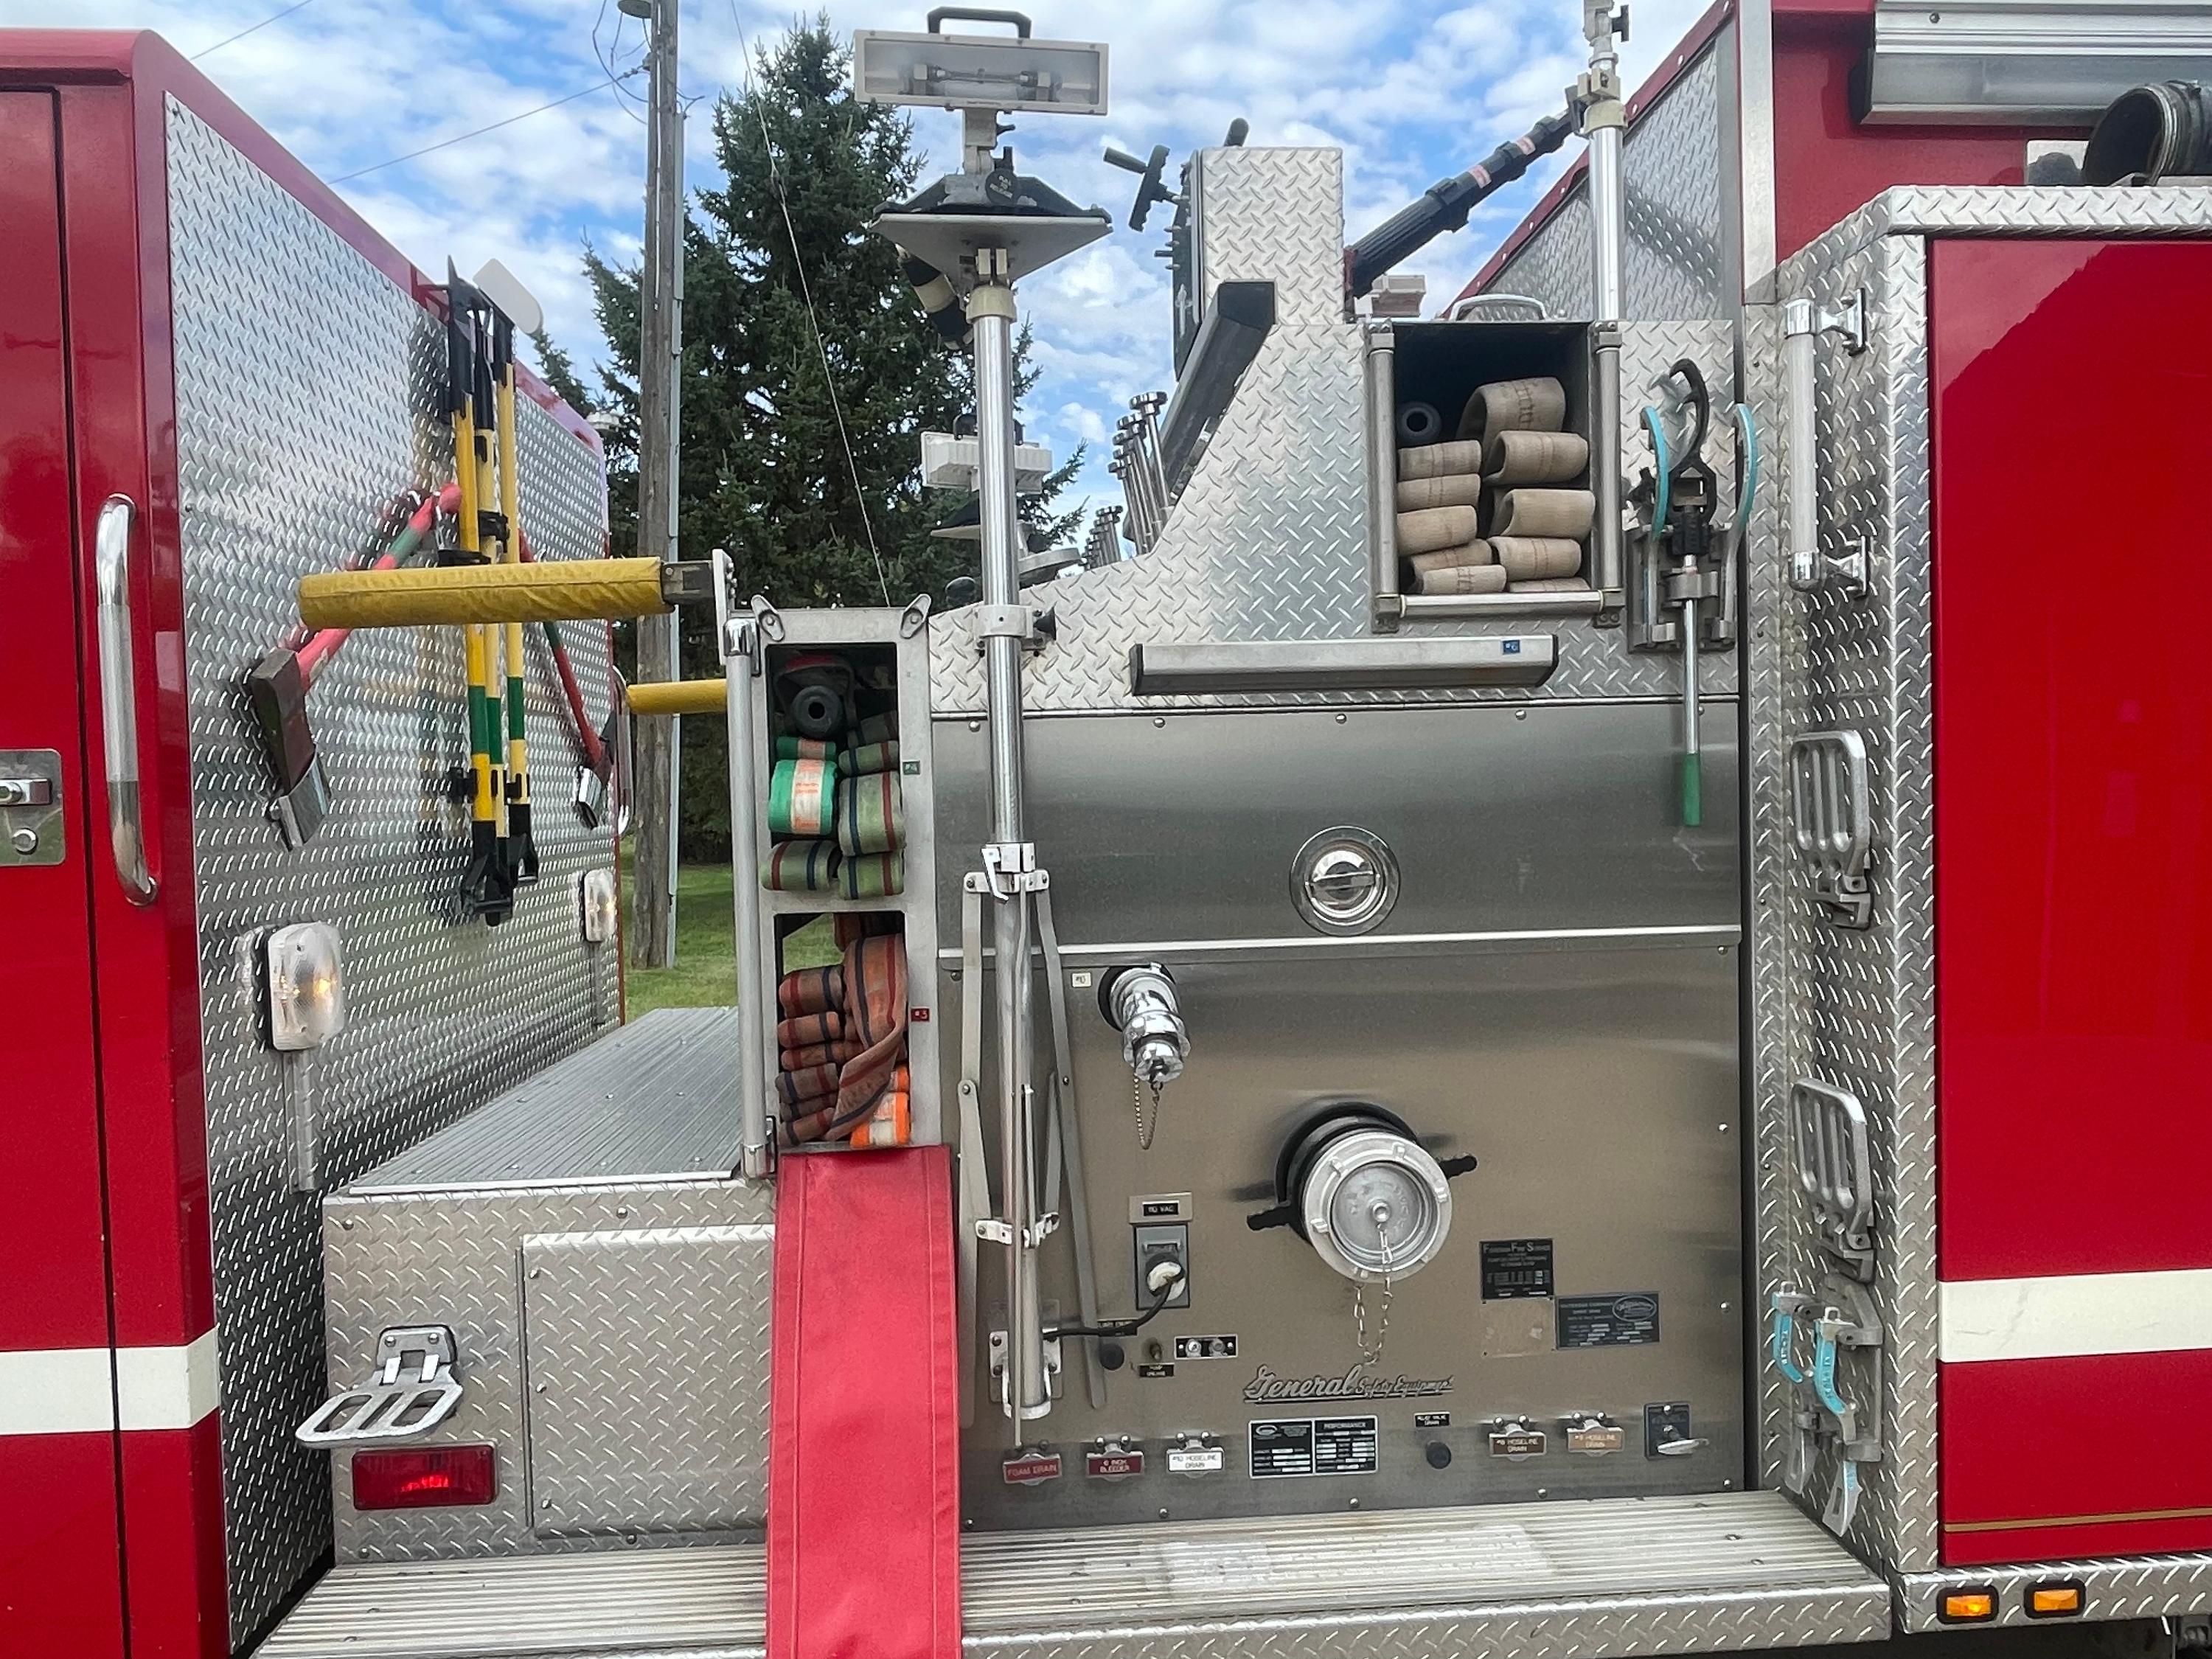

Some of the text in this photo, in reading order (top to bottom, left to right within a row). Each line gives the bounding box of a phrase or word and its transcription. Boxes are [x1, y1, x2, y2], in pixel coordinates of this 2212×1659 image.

[1244, 1364, 1363, 1399] General
[1355, 1376, 1395, 1398] Safety
[1185, 1454, 1217, 1462] HOSELINE
[1007, 1464, 1057, 1477] FOAM DRAIN
[1185, 1461, 1205, 1470] DRAIN
